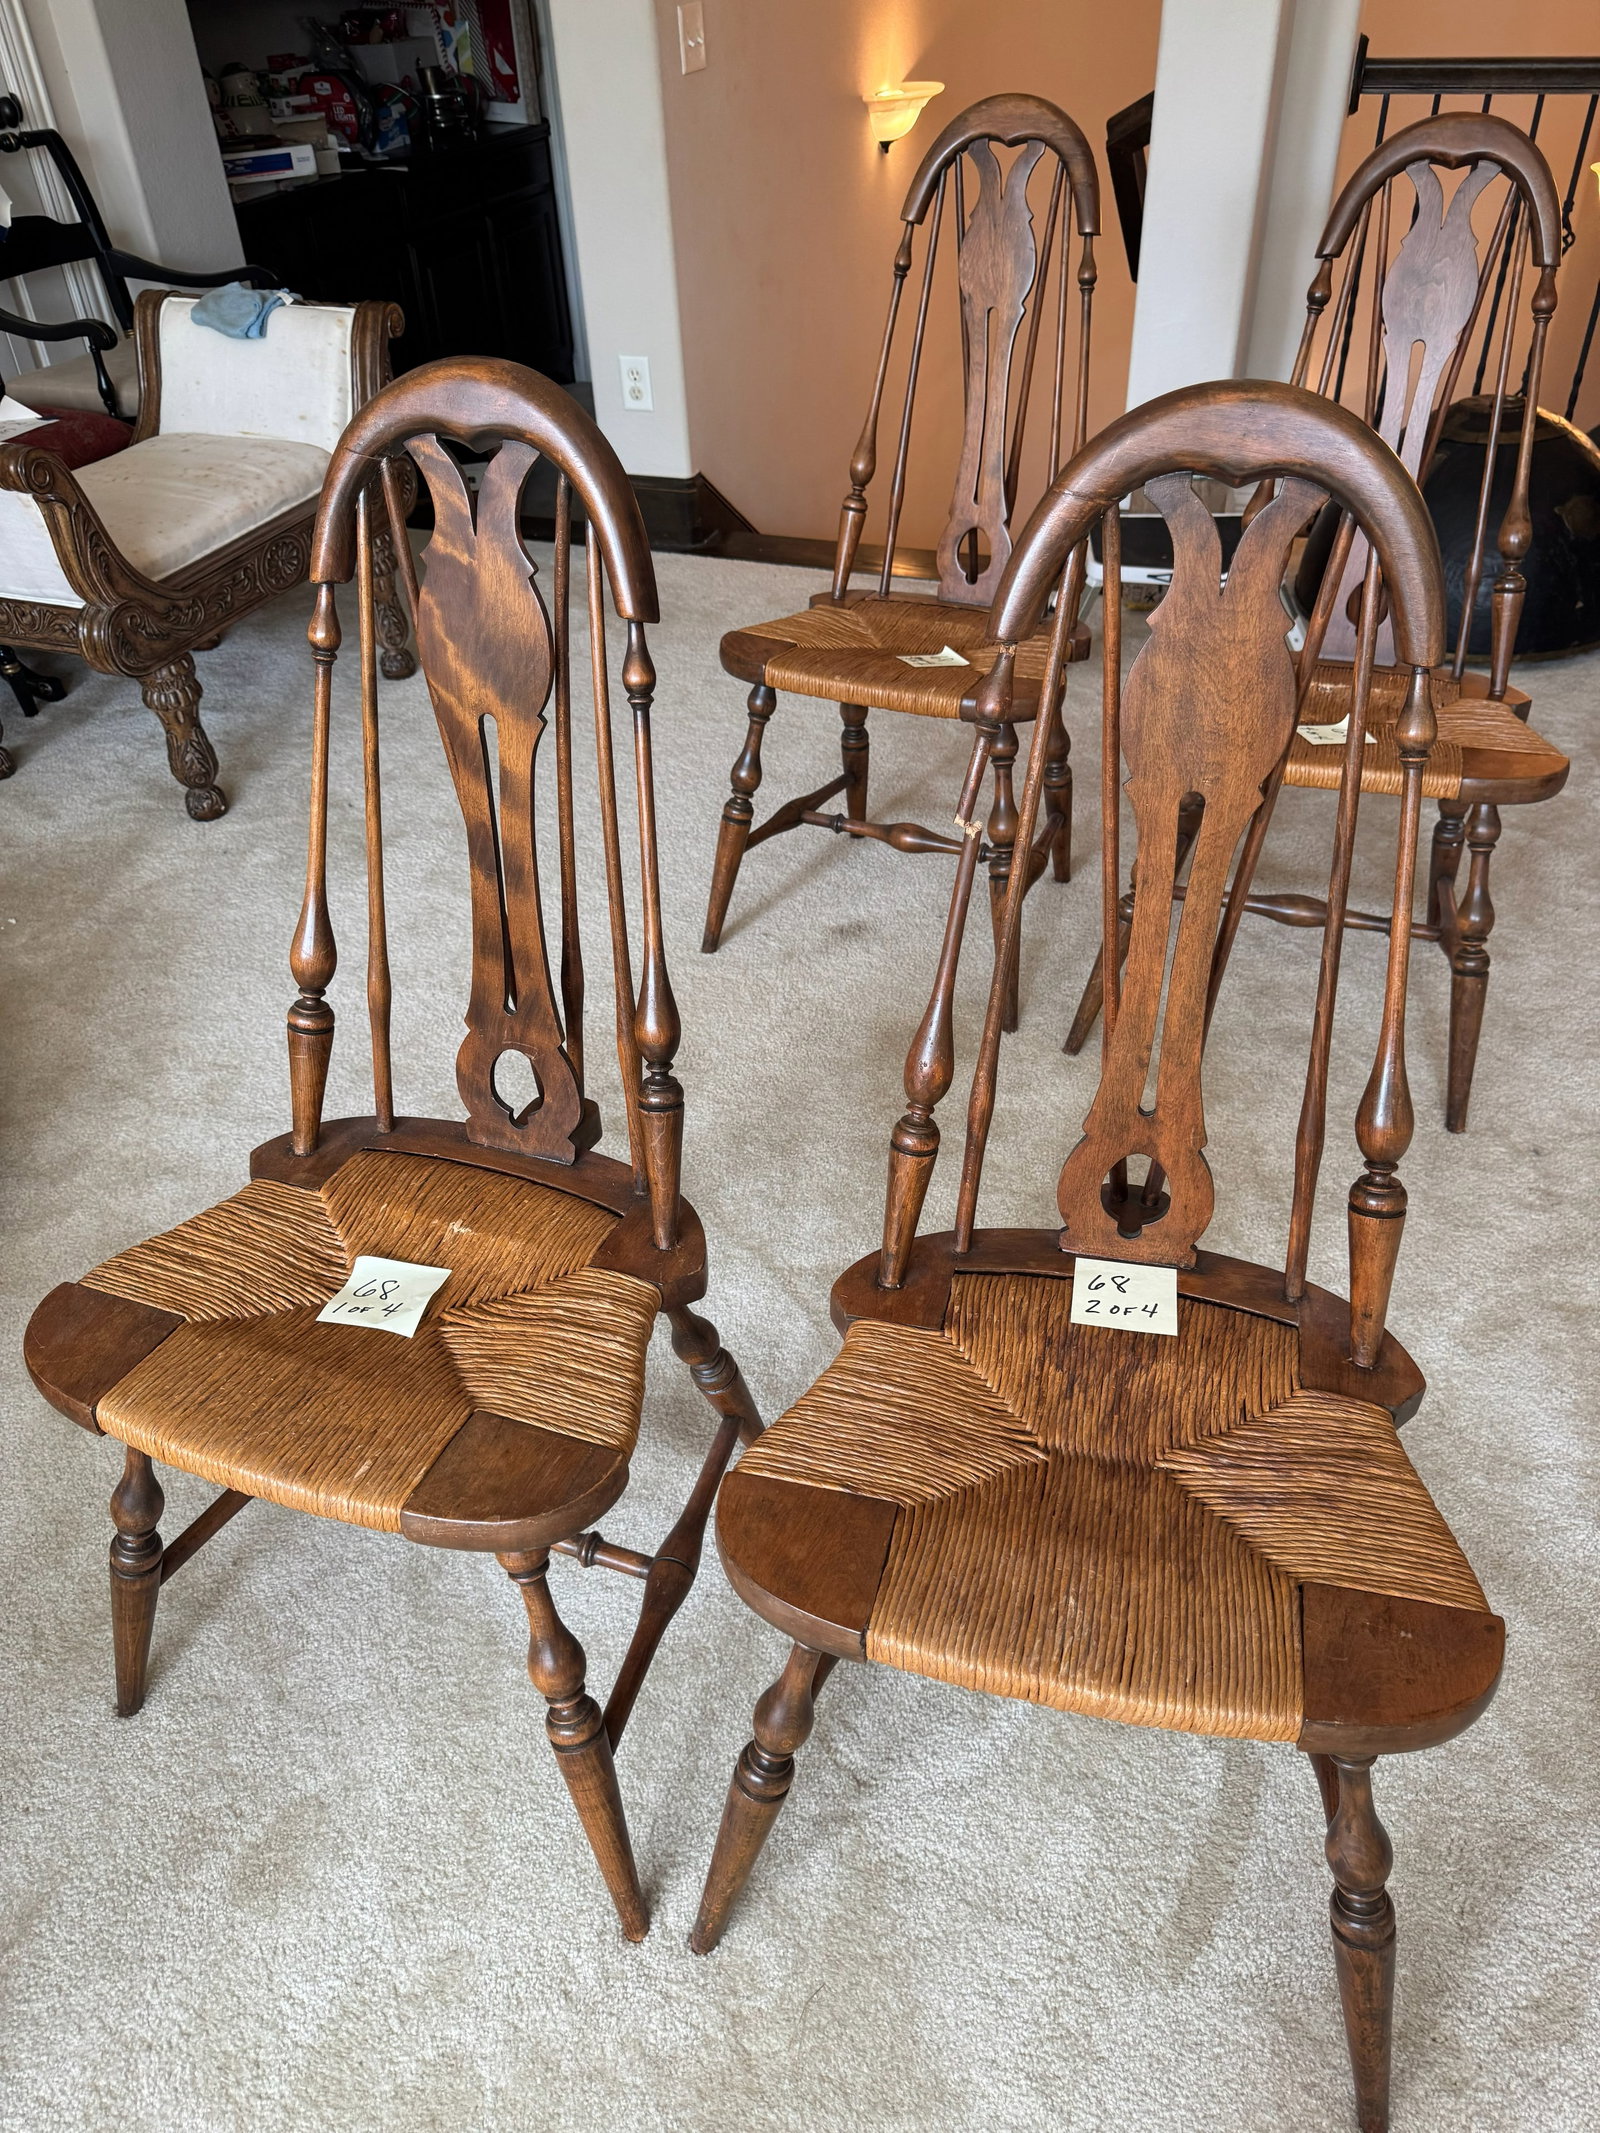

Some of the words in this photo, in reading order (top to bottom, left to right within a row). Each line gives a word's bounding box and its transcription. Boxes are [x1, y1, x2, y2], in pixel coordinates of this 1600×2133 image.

[352, 1278, 400, 1300] 68
[1087, 1274, 1131, 1294] 68
[332, 1302, 348, 1314] 1
[381, 1302, 404, 1318] 4
[1085, 1299, 1101, 1314] 2
[1141, 1303, 1159, 1318] 4
